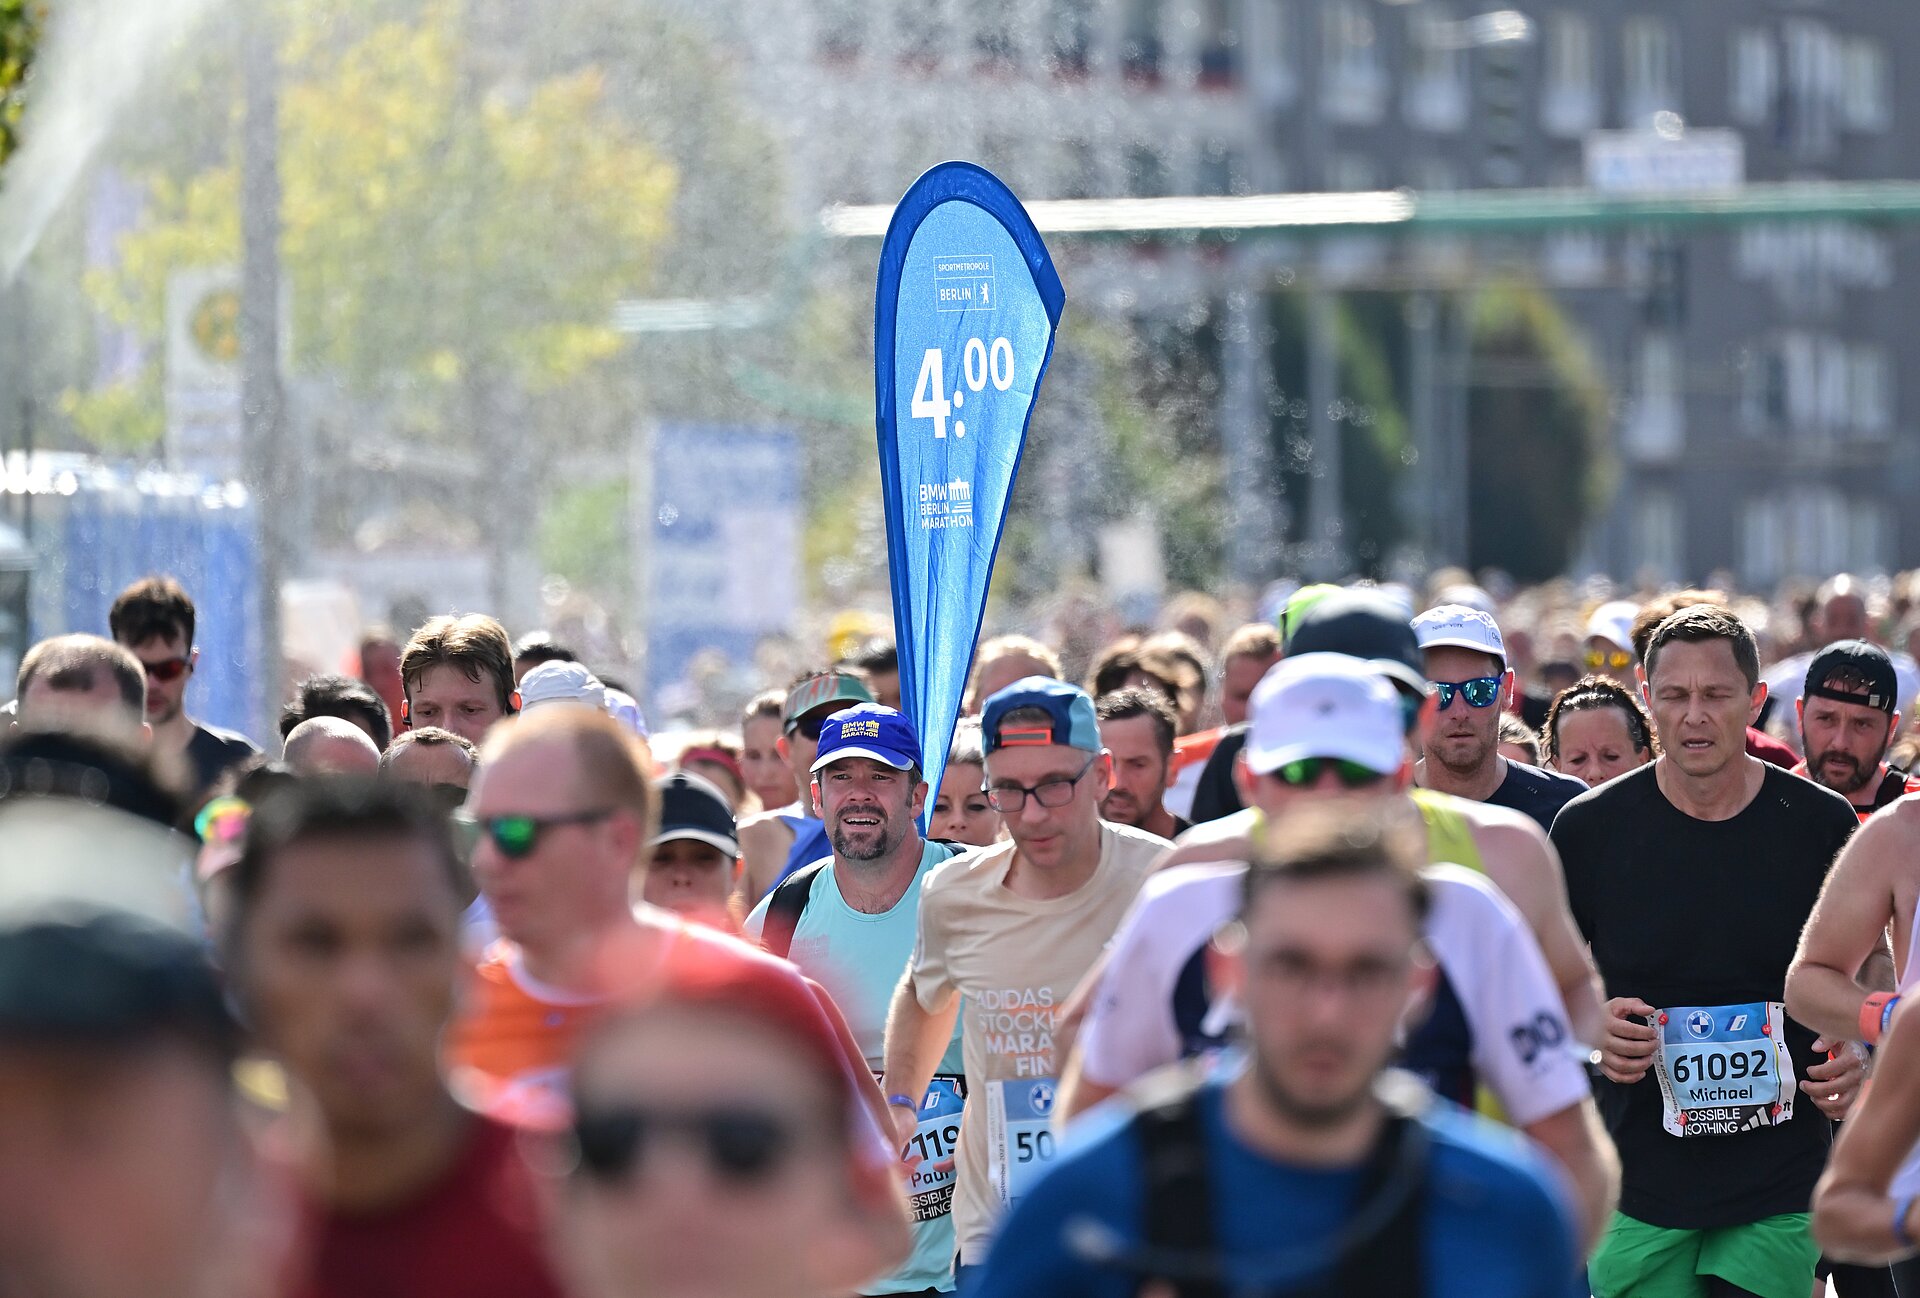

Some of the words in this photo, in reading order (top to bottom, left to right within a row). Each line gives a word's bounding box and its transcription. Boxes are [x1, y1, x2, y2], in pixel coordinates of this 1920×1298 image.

[938, 262, 990, 272] SPORTMETROPOLE
[940, 287, 972, 301] BERLIN
[919, 483, 948, 502] BMW
[920, 502, 950, 516] BERLIN
[921, 514, 974, 530] MARATHON
[841, 726, 865, 735] BERLIN
[842, 720, 866, 730] BMW
[841, 730, 879, 739] MARATHON
[975, 986, 1054, 1010] ADIDAS
[986, 1032, 1055, 1055] MARA
[1673, 1049, 1768, 1084] 61092
[1689, 1085, 1753, 1103] Michael
